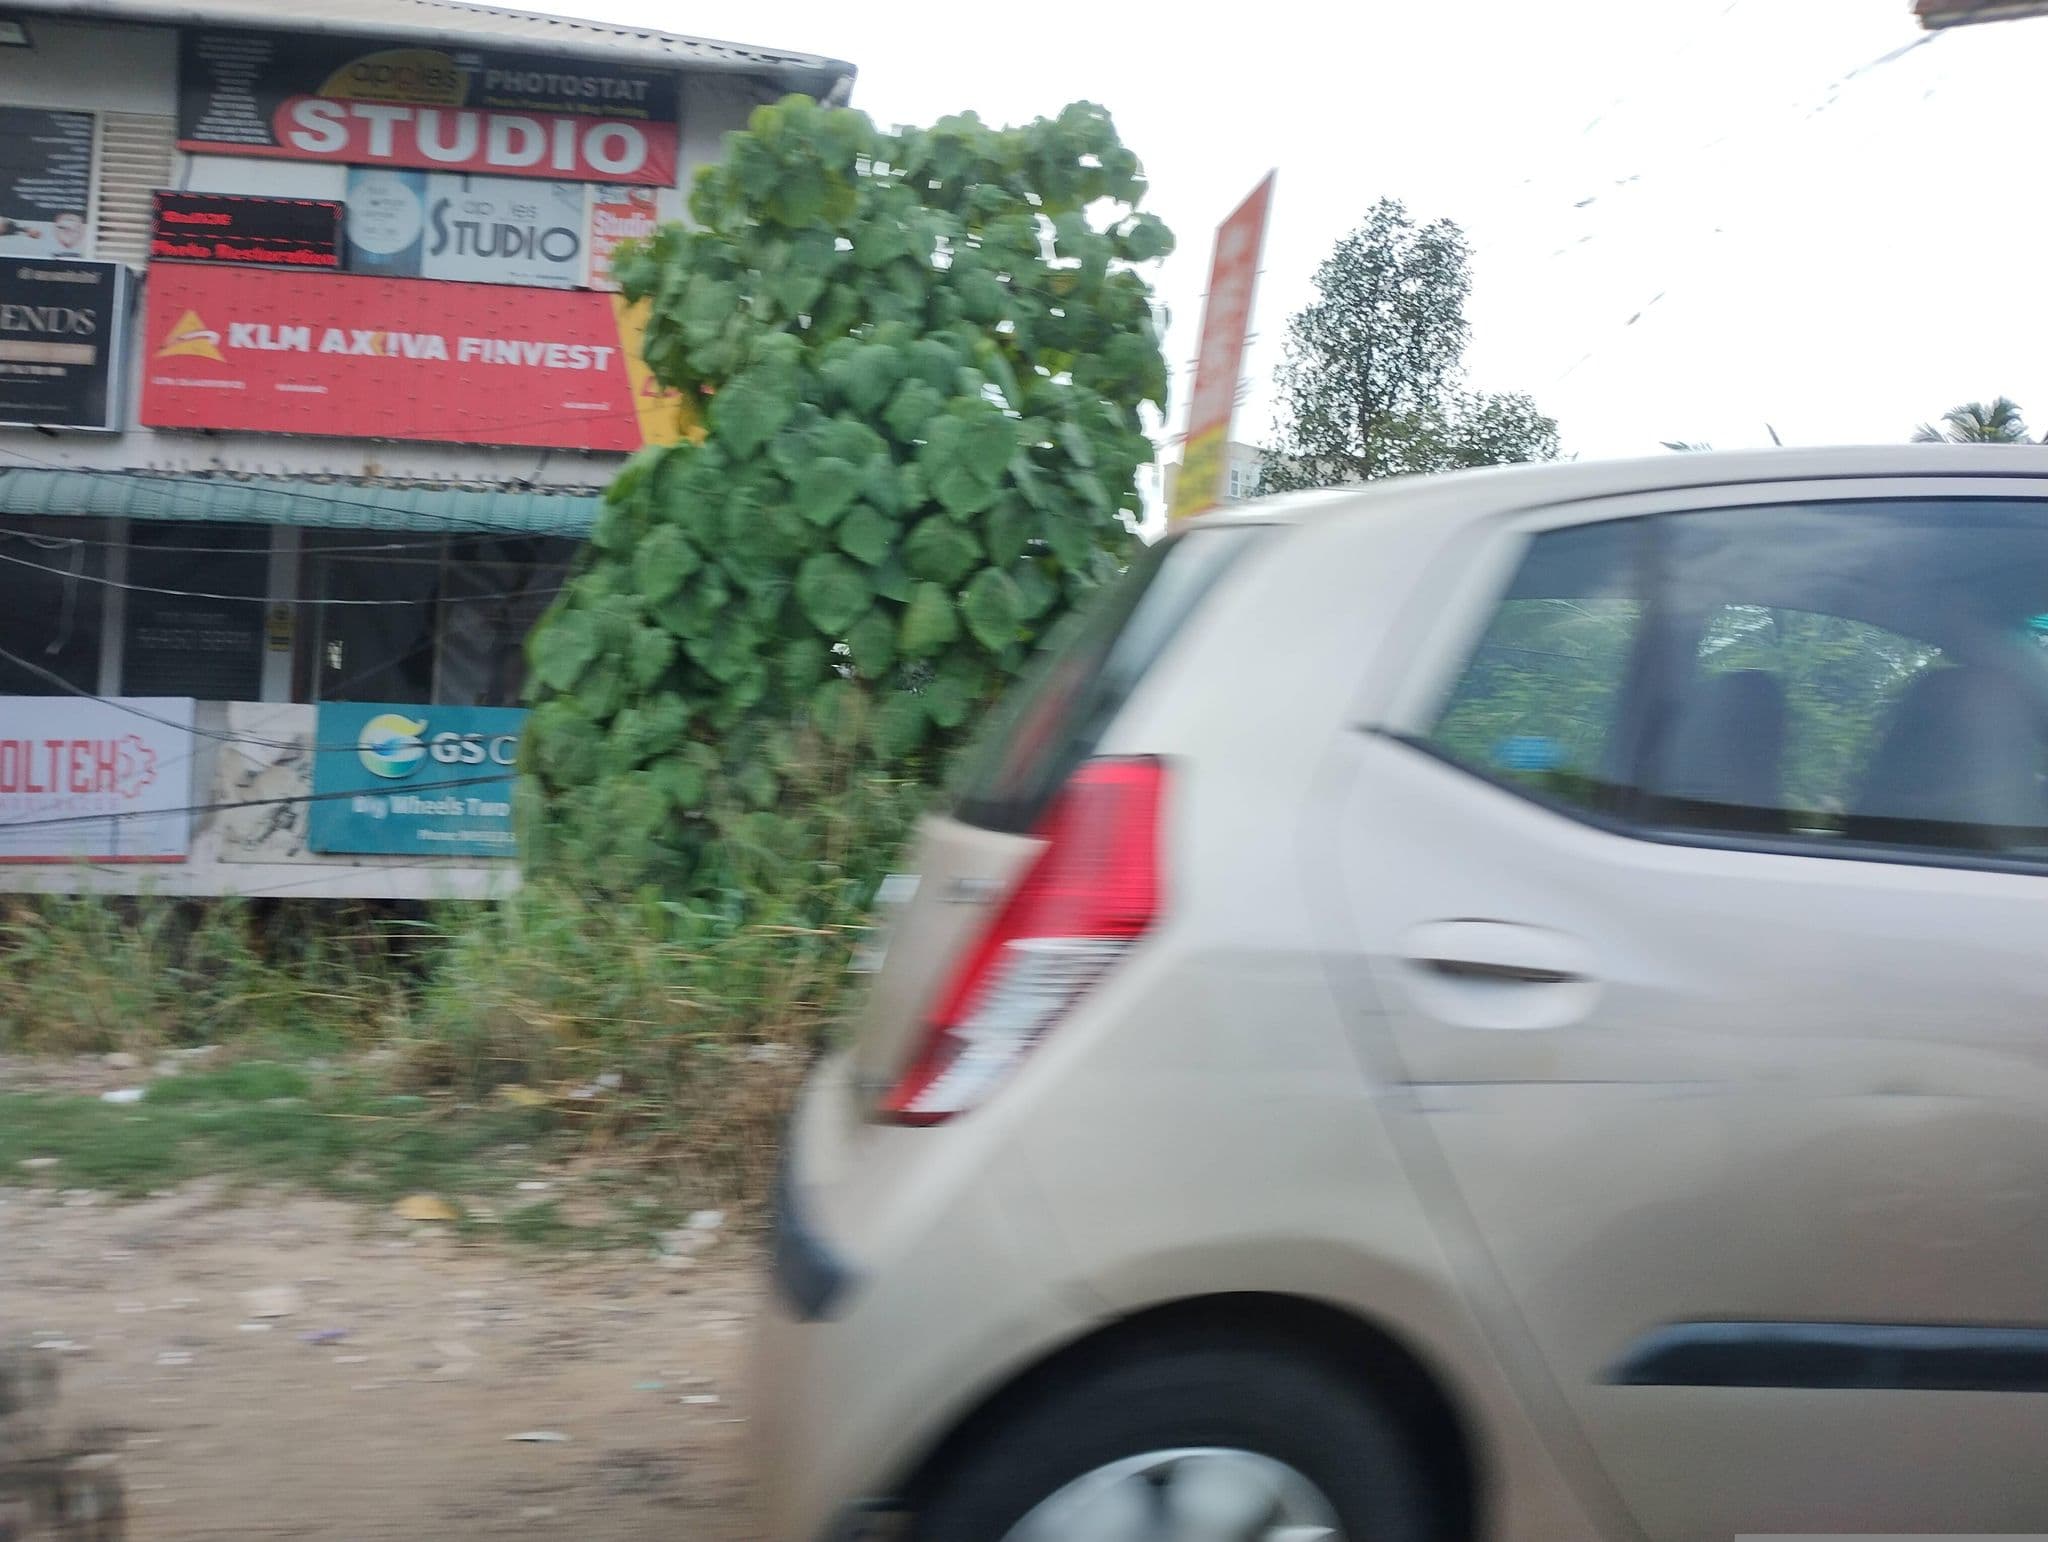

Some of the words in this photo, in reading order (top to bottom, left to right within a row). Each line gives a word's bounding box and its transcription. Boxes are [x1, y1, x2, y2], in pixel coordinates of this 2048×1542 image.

[484, 69, 649, 101] PHOTOSTAT
[290, 99, 648, 175] STUDIO
[0, 304, 97, 335] ENDS
[229, 322, 311, 352] KLM
[456, 336, 615, 371] FINVEST
